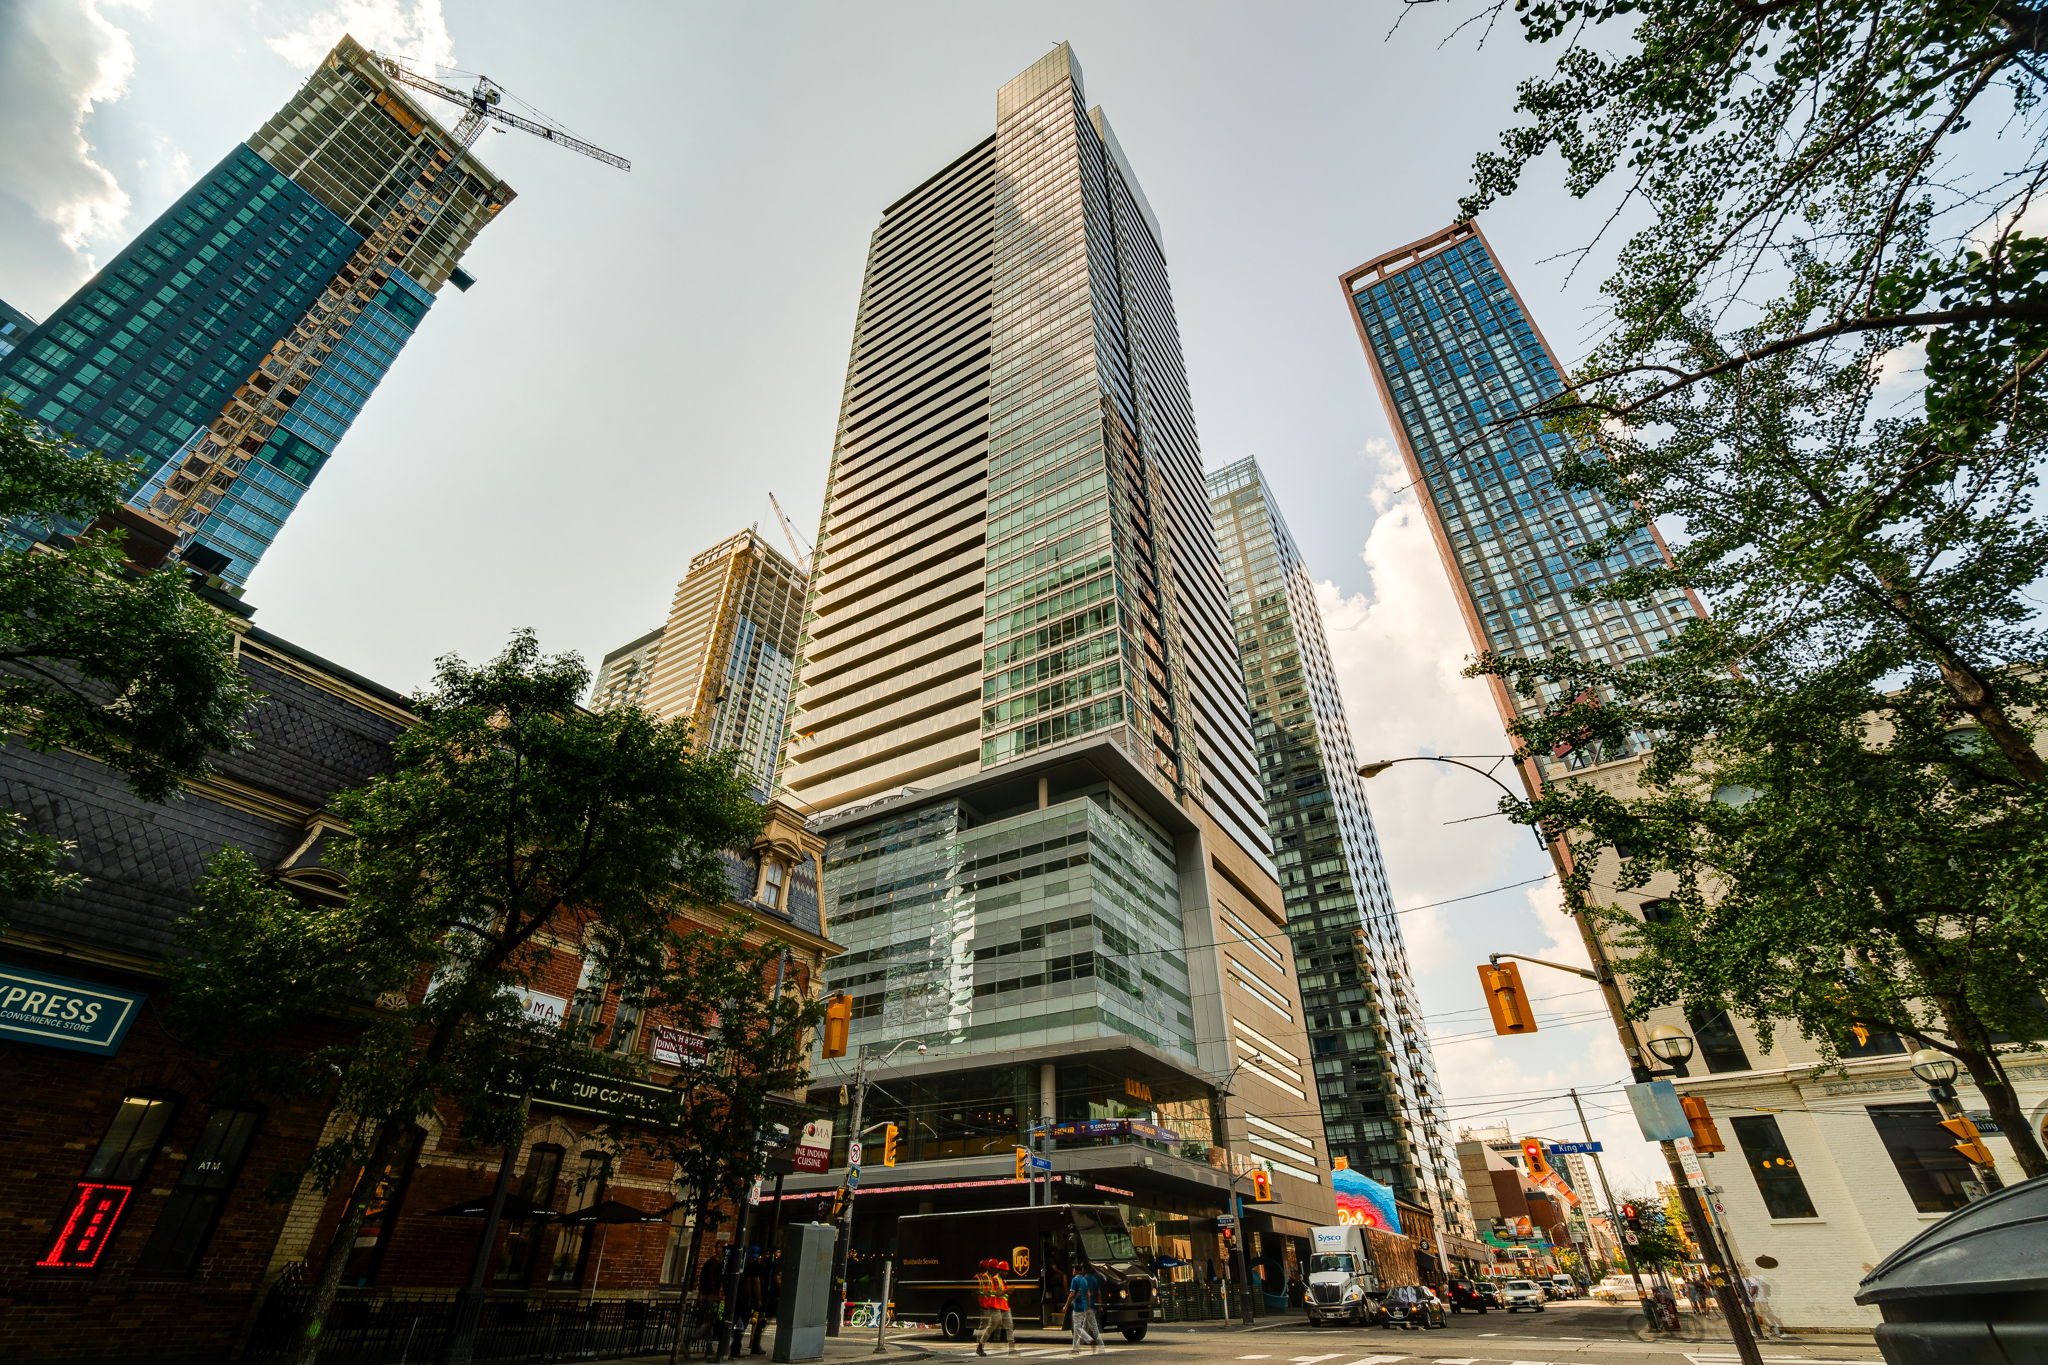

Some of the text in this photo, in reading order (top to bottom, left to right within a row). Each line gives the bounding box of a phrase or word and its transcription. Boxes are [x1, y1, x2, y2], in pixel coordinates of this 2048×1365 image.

[1, 1010, 92, 1033] CONVENIENCE STORE
[572, 1082, 599, 1099] CUP
[1974, 1121, 1998, 1131] King
[1558, 1143, 1578, 1153] King
[1584, 1142, 1593, 1151] W
[806, 1148, 829, 1160] INDIAN
[198, 1161, 221, 1171] ATM
[797, 1156, 821, 1168] CUISINE
[77, 1199, 112, 1252] HERE
[1014, 1255, 1029, 1272] ups
